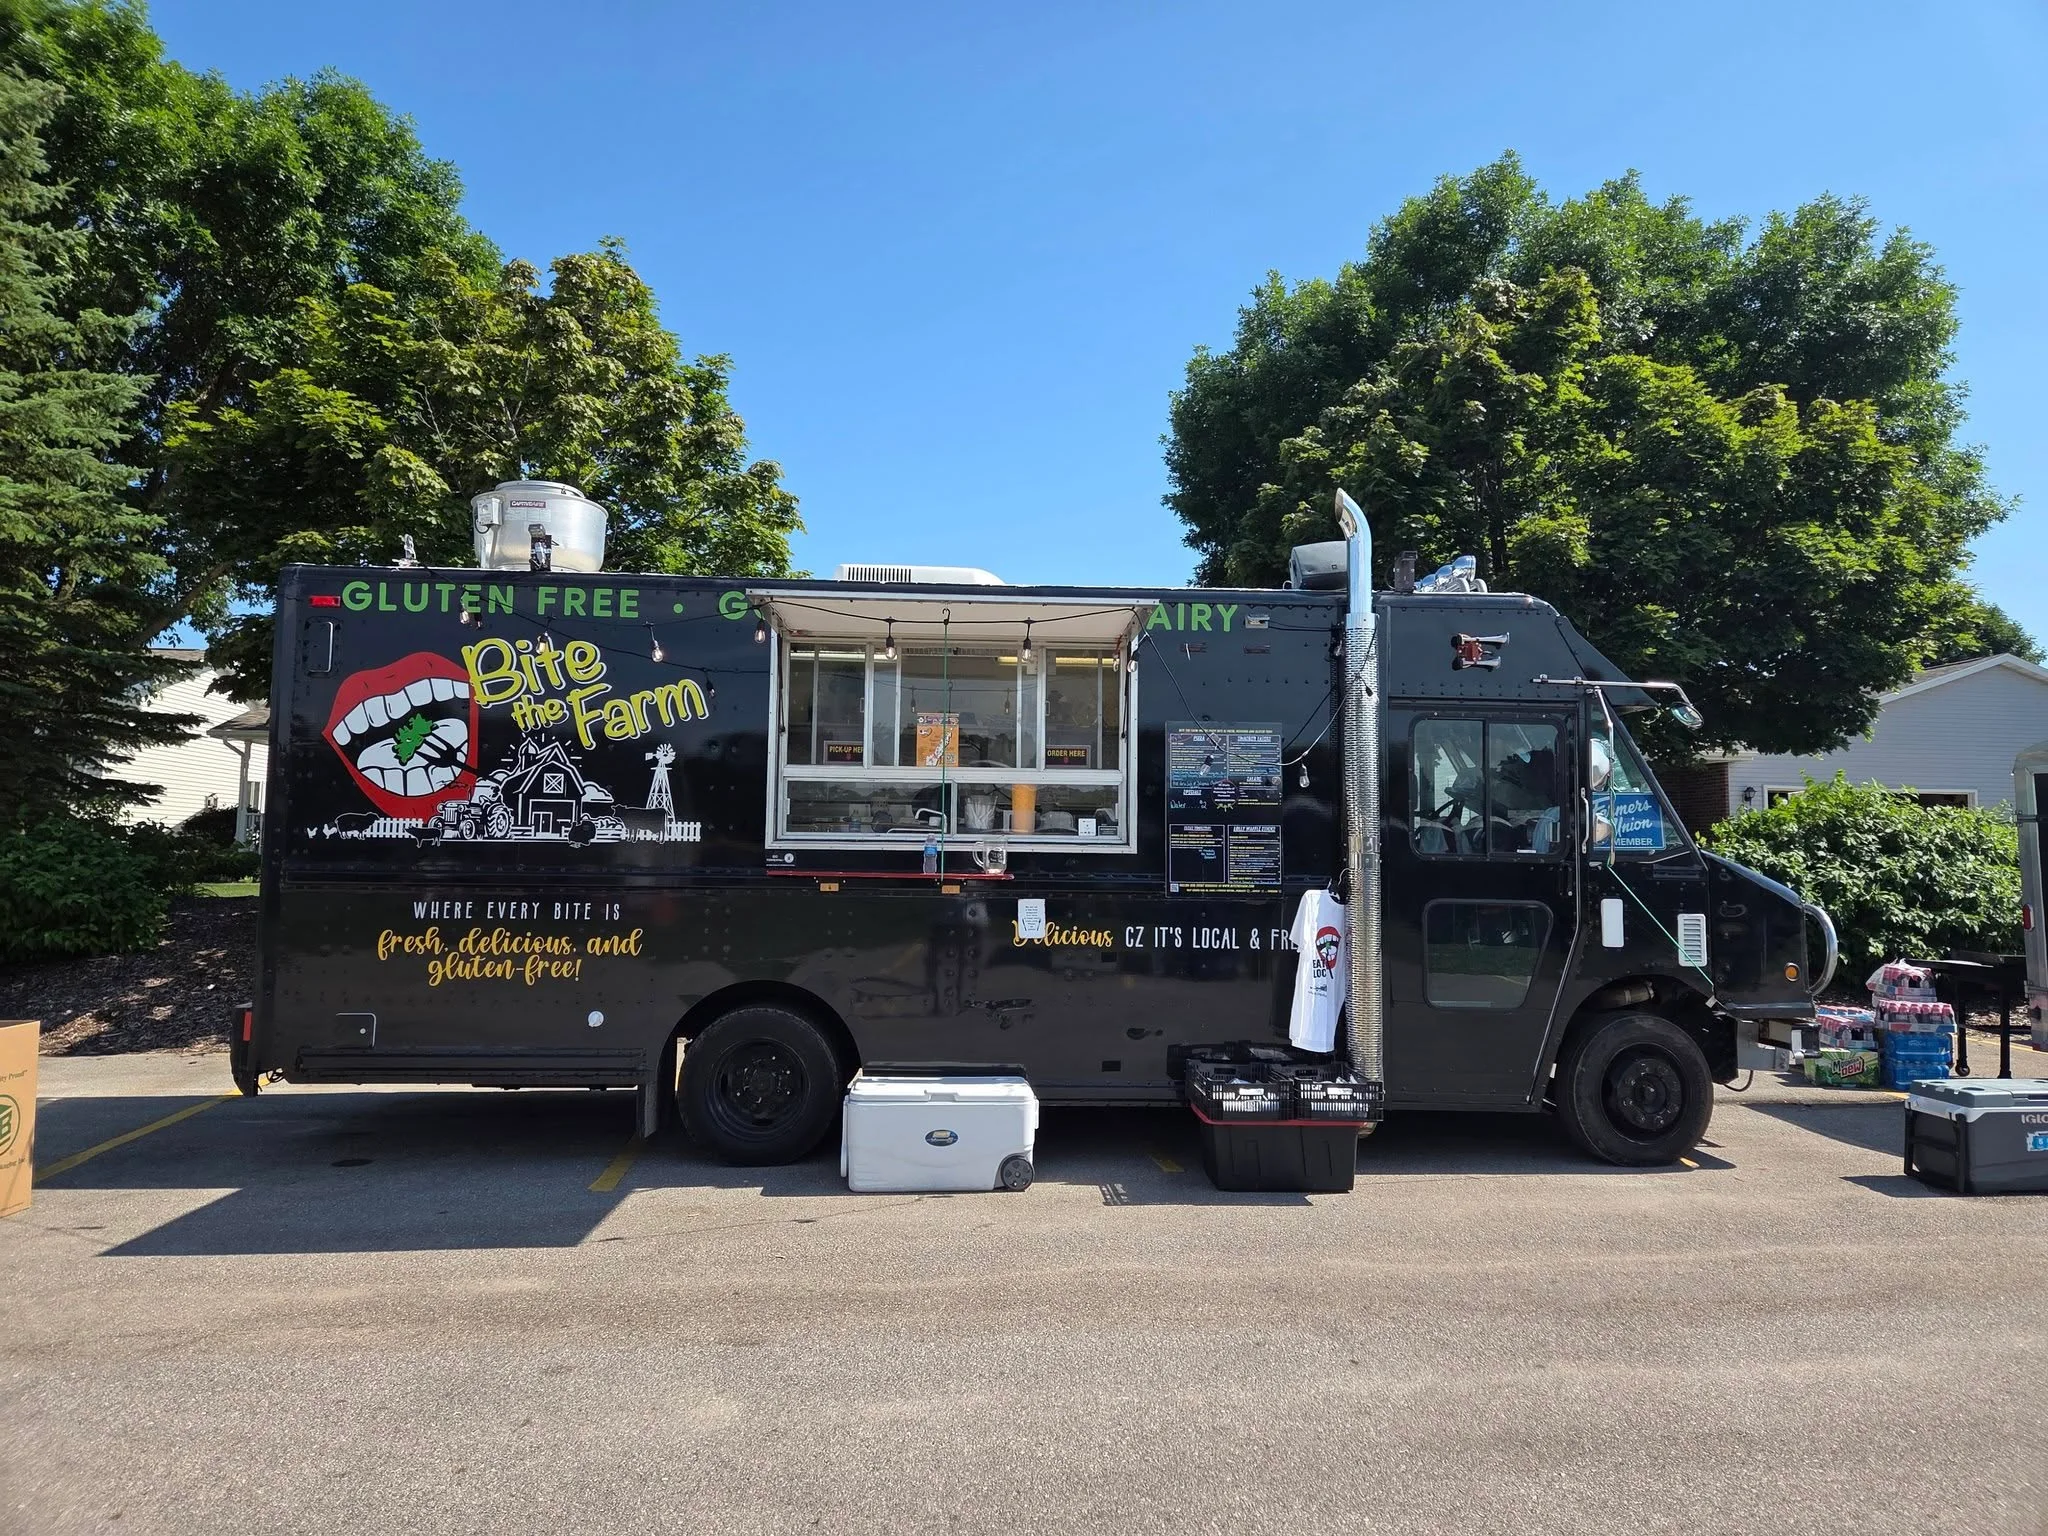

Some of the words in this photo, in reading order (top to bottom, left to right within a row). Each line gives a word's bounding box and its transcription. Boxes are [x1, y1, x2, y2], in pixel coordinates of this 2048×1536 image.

[342, 581, 514, 615] GLUTEN
[537, 586, 640, 618] FREE
[1146, 603, 1239, 632] AIRY
[461, 637, 606, 706] Bite
[511, 696, 569, 733] the
[567, 678, 710, 749] Farm
[1593, 796, 1652, 818] Famers
[1614, 837, 1653, 846] MEMBER
[413, 901, 473, 919] WHERE
[487, 901, 540, 920] EVERY
[554, 902, 591, 920] BITE
[605, 903, 621, 921] IS
[586, 928, 643, 956] and
[1012, 920, 1113, 947] licious
[1125, 926, 1144, 947] CZ
[1154, 926, 1182, 948] IT'S
[1193, 927, 1240, 949] LOCAL
[1250, 928, 1261, 950] &
[428, 952, 582, 986] gluten-free!
[2021, 1114, 2048, 1124] IGLO
